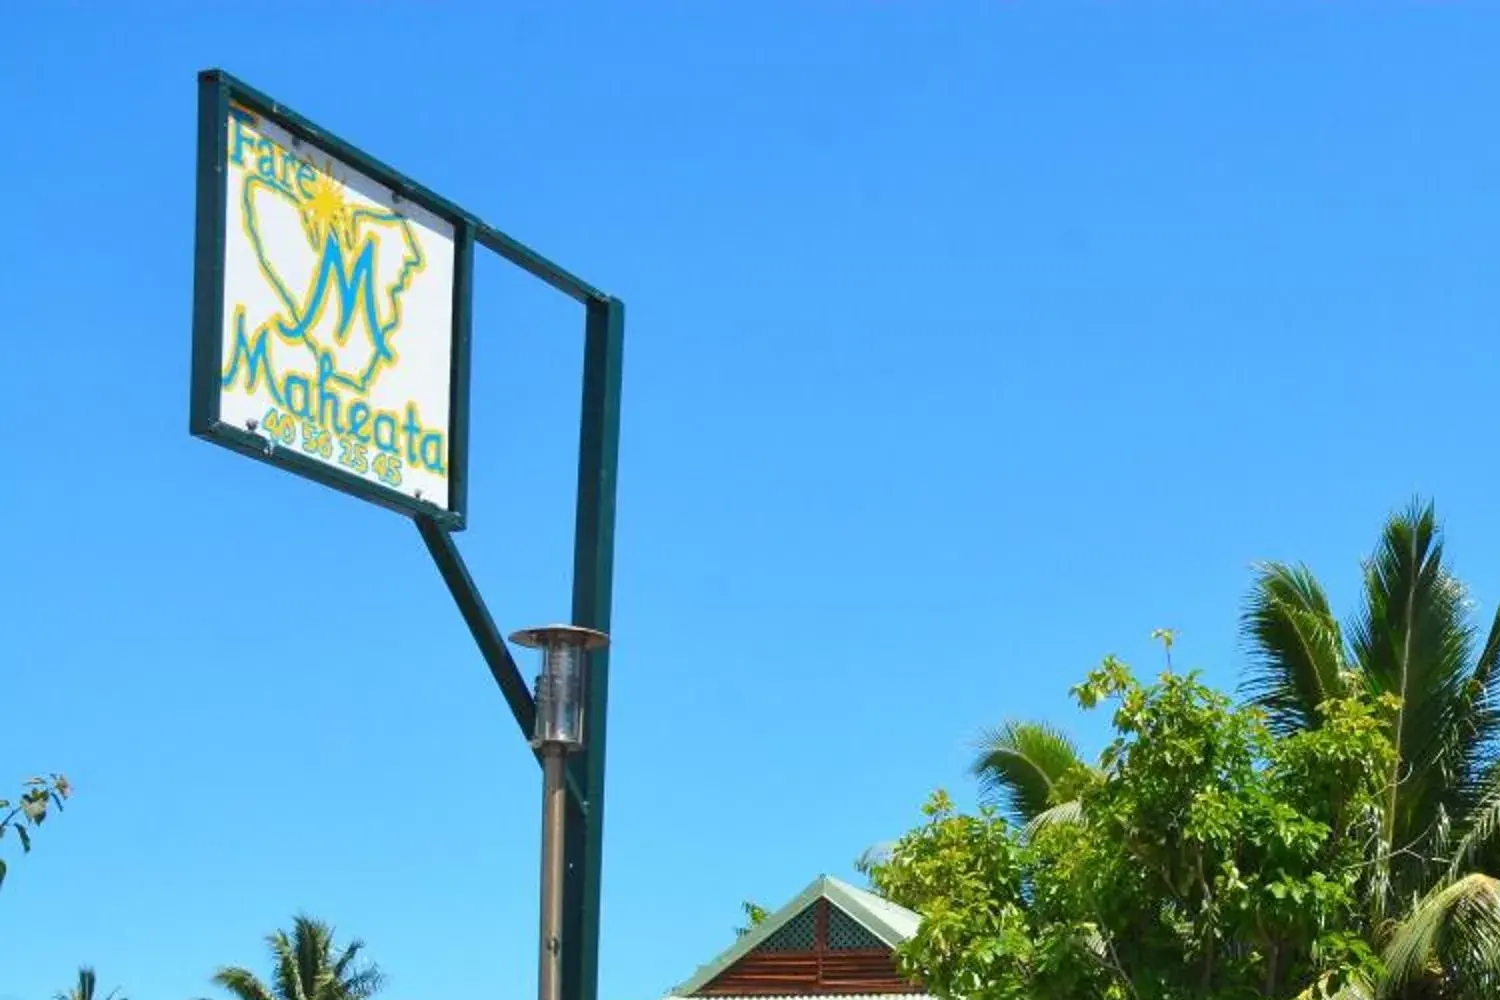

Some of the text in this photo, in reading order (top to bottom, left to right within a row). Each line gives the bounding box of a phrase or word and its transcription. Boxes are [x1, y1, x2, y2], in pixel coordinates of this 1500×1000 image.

[228, 107, 317, 201] Fare
[276, 225, 395, 363] M
[222, 306, 448, 474] Maheata
